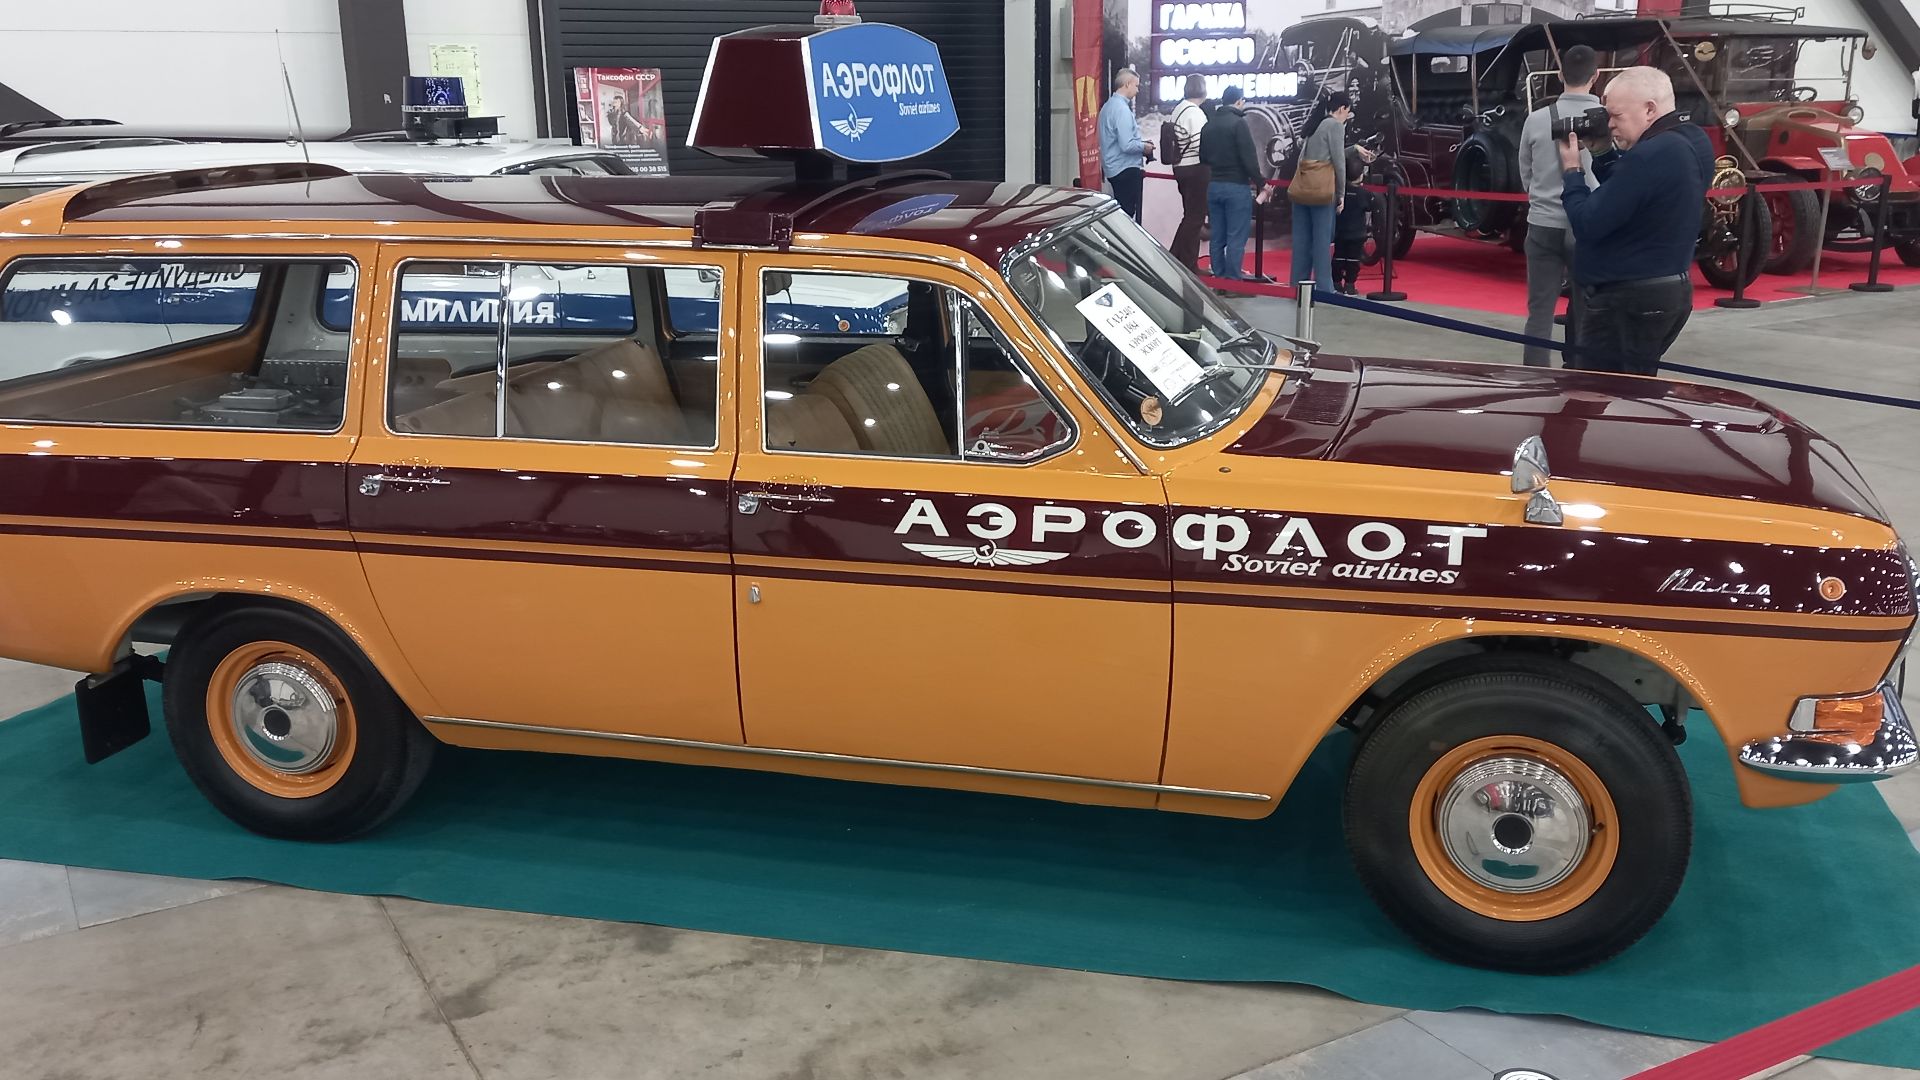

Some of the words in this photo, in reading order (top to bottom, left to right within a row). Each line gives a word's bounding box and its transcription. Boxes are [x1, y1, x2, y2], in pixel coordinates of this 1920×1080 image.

[597, 73, 634, 82] Таксофон
[635, 73, 656, 81] СССР
[822, 62, 935, 103] АЭРОФЛОТ
[899, 102, 918, 116] Soviet
[918, 101, 941, 115] airlines
[401, 299, 555, 325] МИЛИИЯ
[893, 498, 1488, 566] АЭРОФЛОТ
[1221, 553, 1322, 578] Soviet
[1331, 560, 1460, 584] airlines
